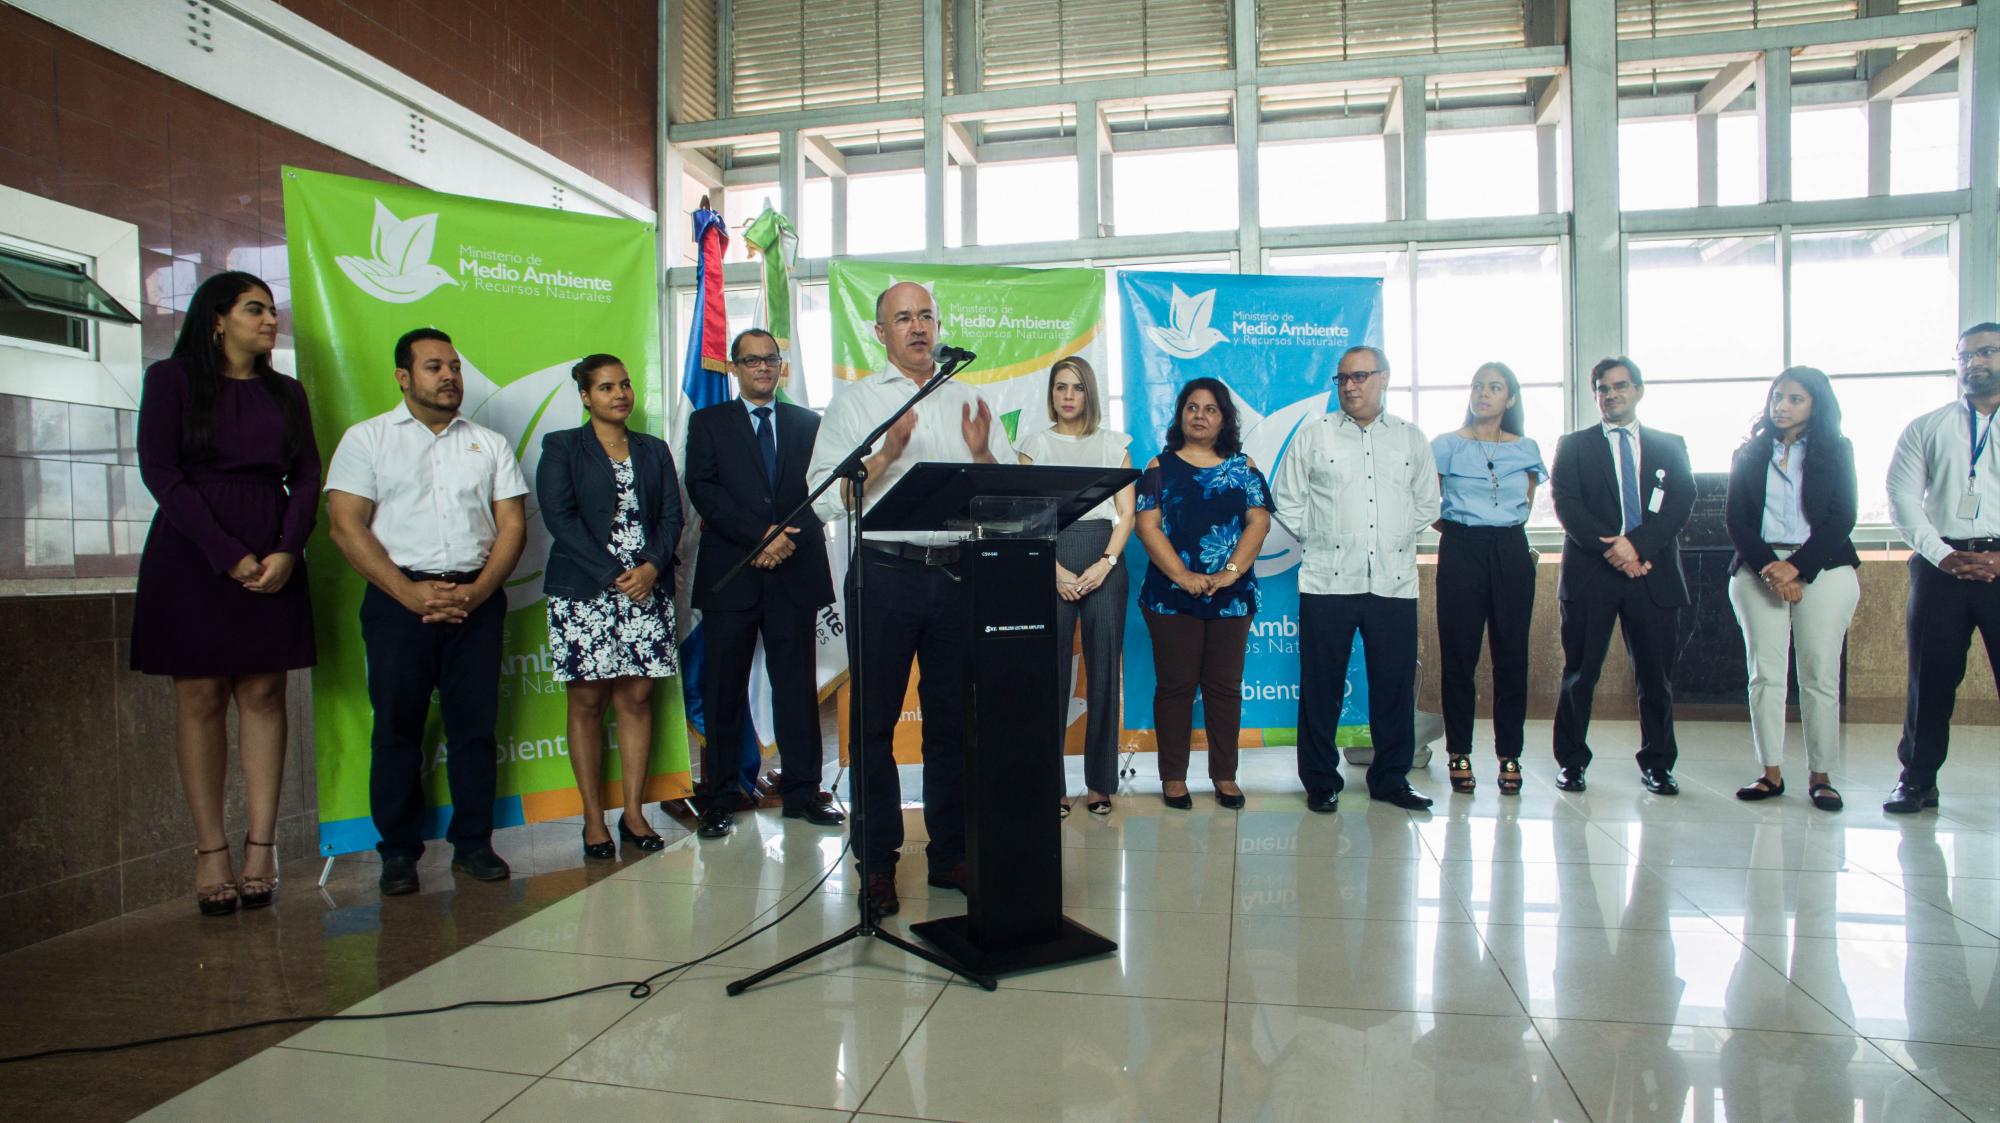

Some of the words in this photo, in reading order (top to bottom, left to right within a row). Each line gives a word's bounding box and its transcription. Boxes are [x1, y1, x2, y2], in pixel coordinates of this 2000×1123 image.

[460, 244, 522, 264] Ministerio
[526, 253, 543, 266] de
[459, 258, 520, 281] Medio
[523, 266, 613, 291] Ambiente
[460, 279, 468, 292] y
[475, 277, 541, 297] Recursos
[546, 286, 612, 304] Naturales
[950, 303, 998, 313] Ministerio
[1001, 303, 1014, 314] de
[1232, 310, 1279, 321] Ministerio
[1282, 312, 1294, 322] de
[950, 313, 996, 328] Medio
[999, 314, 1071, 330] Ambiente
[1232, 321, 1277, 335] Medio
[1279, 321, 1349, 337] Ambiente
[961, 327, 1011, 338] Recursos
[1017, 329, 1071, 340] Naturales
[1233, 336, 1239, 346] y
[1243, 335, 1292, 345] Recursos
[1296, 336, 1349, 346] Naturales
